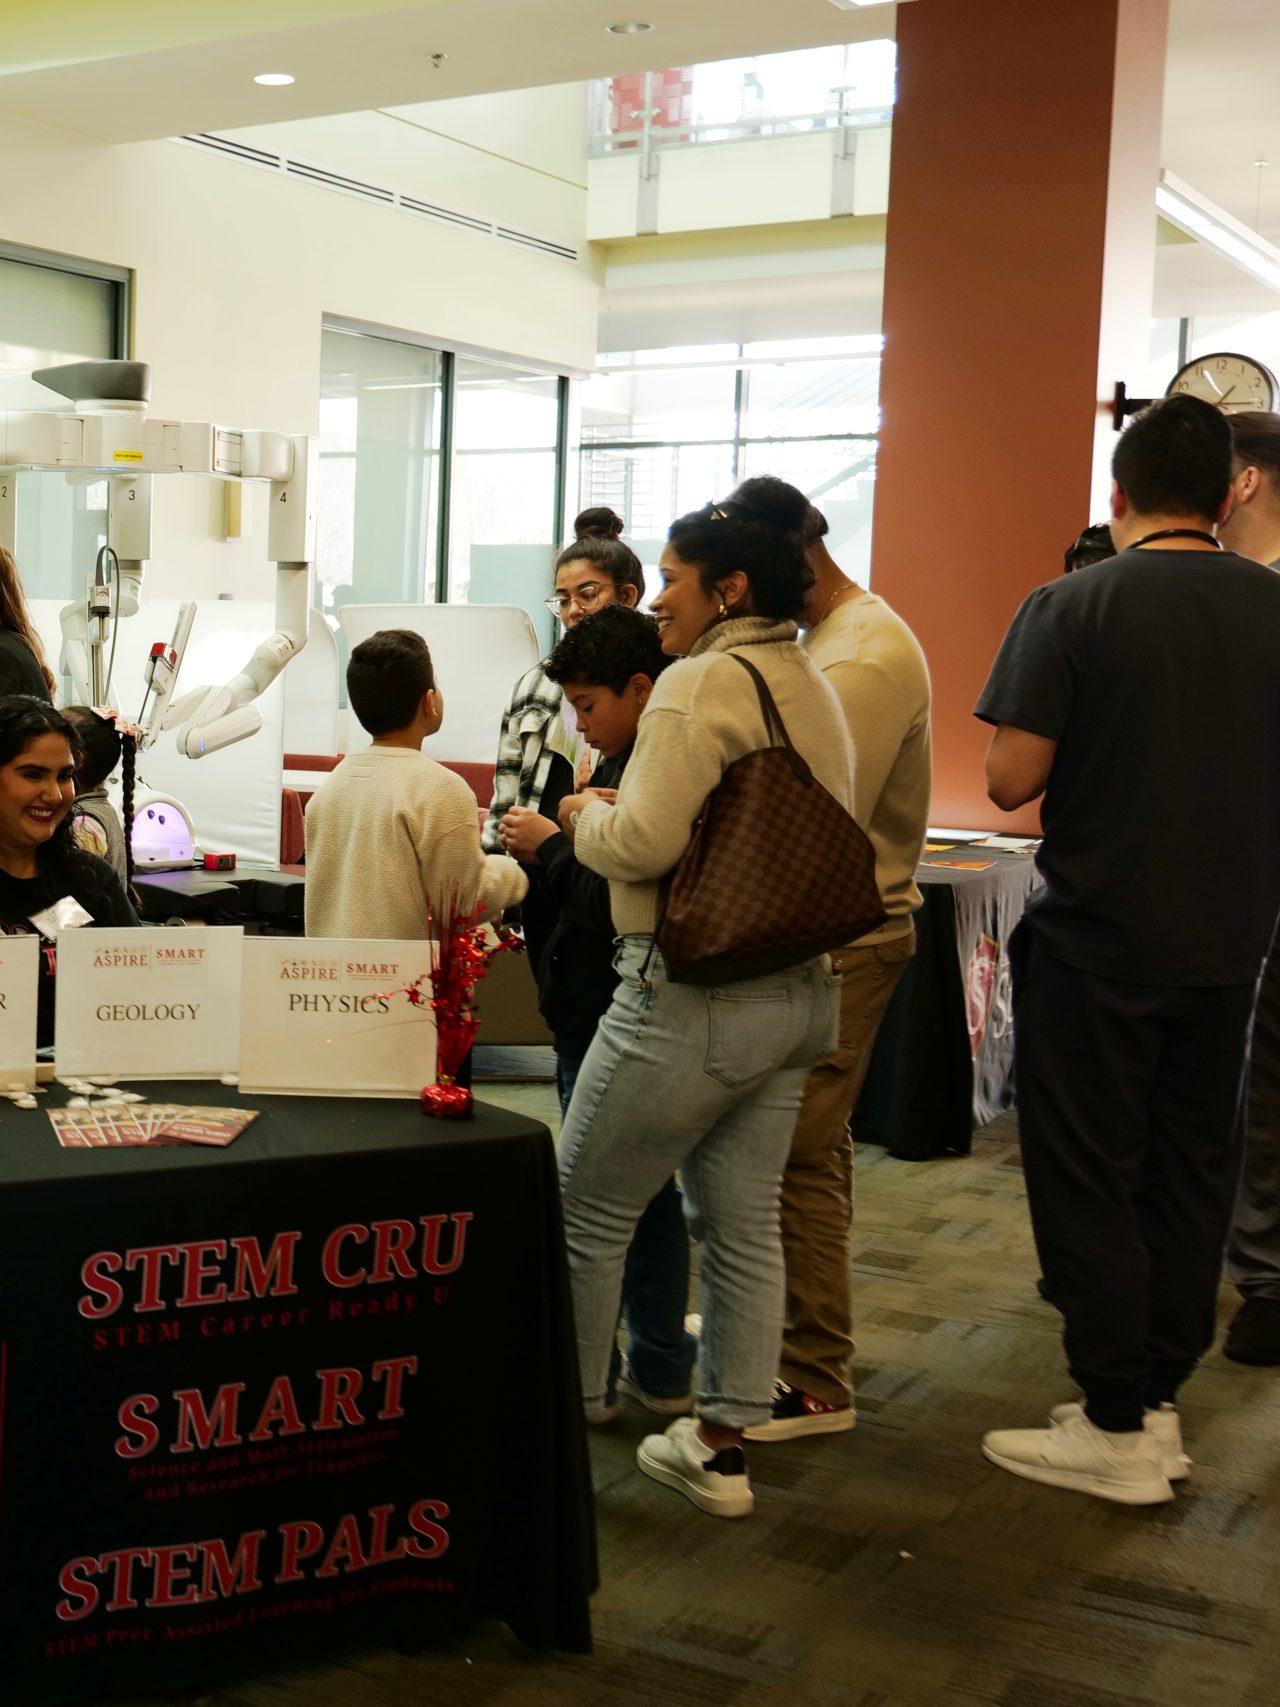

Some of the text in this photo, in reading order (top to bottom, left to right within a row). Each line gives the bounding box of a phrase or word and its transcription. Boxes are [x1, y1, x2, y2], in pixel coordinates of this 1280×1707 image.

[1195, 366, 1204, 376] 11
[1216, 359, 1227, 370] 12
[1254, 377, 1261, 387] 2
[1, 485, 8, 498] 2
[128, 489, 136, 501] 3
[279, 492, 288, 504] 4
[93, 954, 149, 968] ASPIRE
[155, 948, 206, 960] SMART
[280, 966, 338, 980] ASPIRE
[346, 963, 400, 975] SMART
[95, 1003, 201, 1022] GEOLOGY
[288, 993, 390, 1015] PHYSICS
[76, 1211, 475, 1321] STEM CRU
[91, 1283, 451, 1352] STEM Career Ready U
[113, 1355, 418, 1459] SMART
[55, 1499, 451, 1621] STEM PALS
